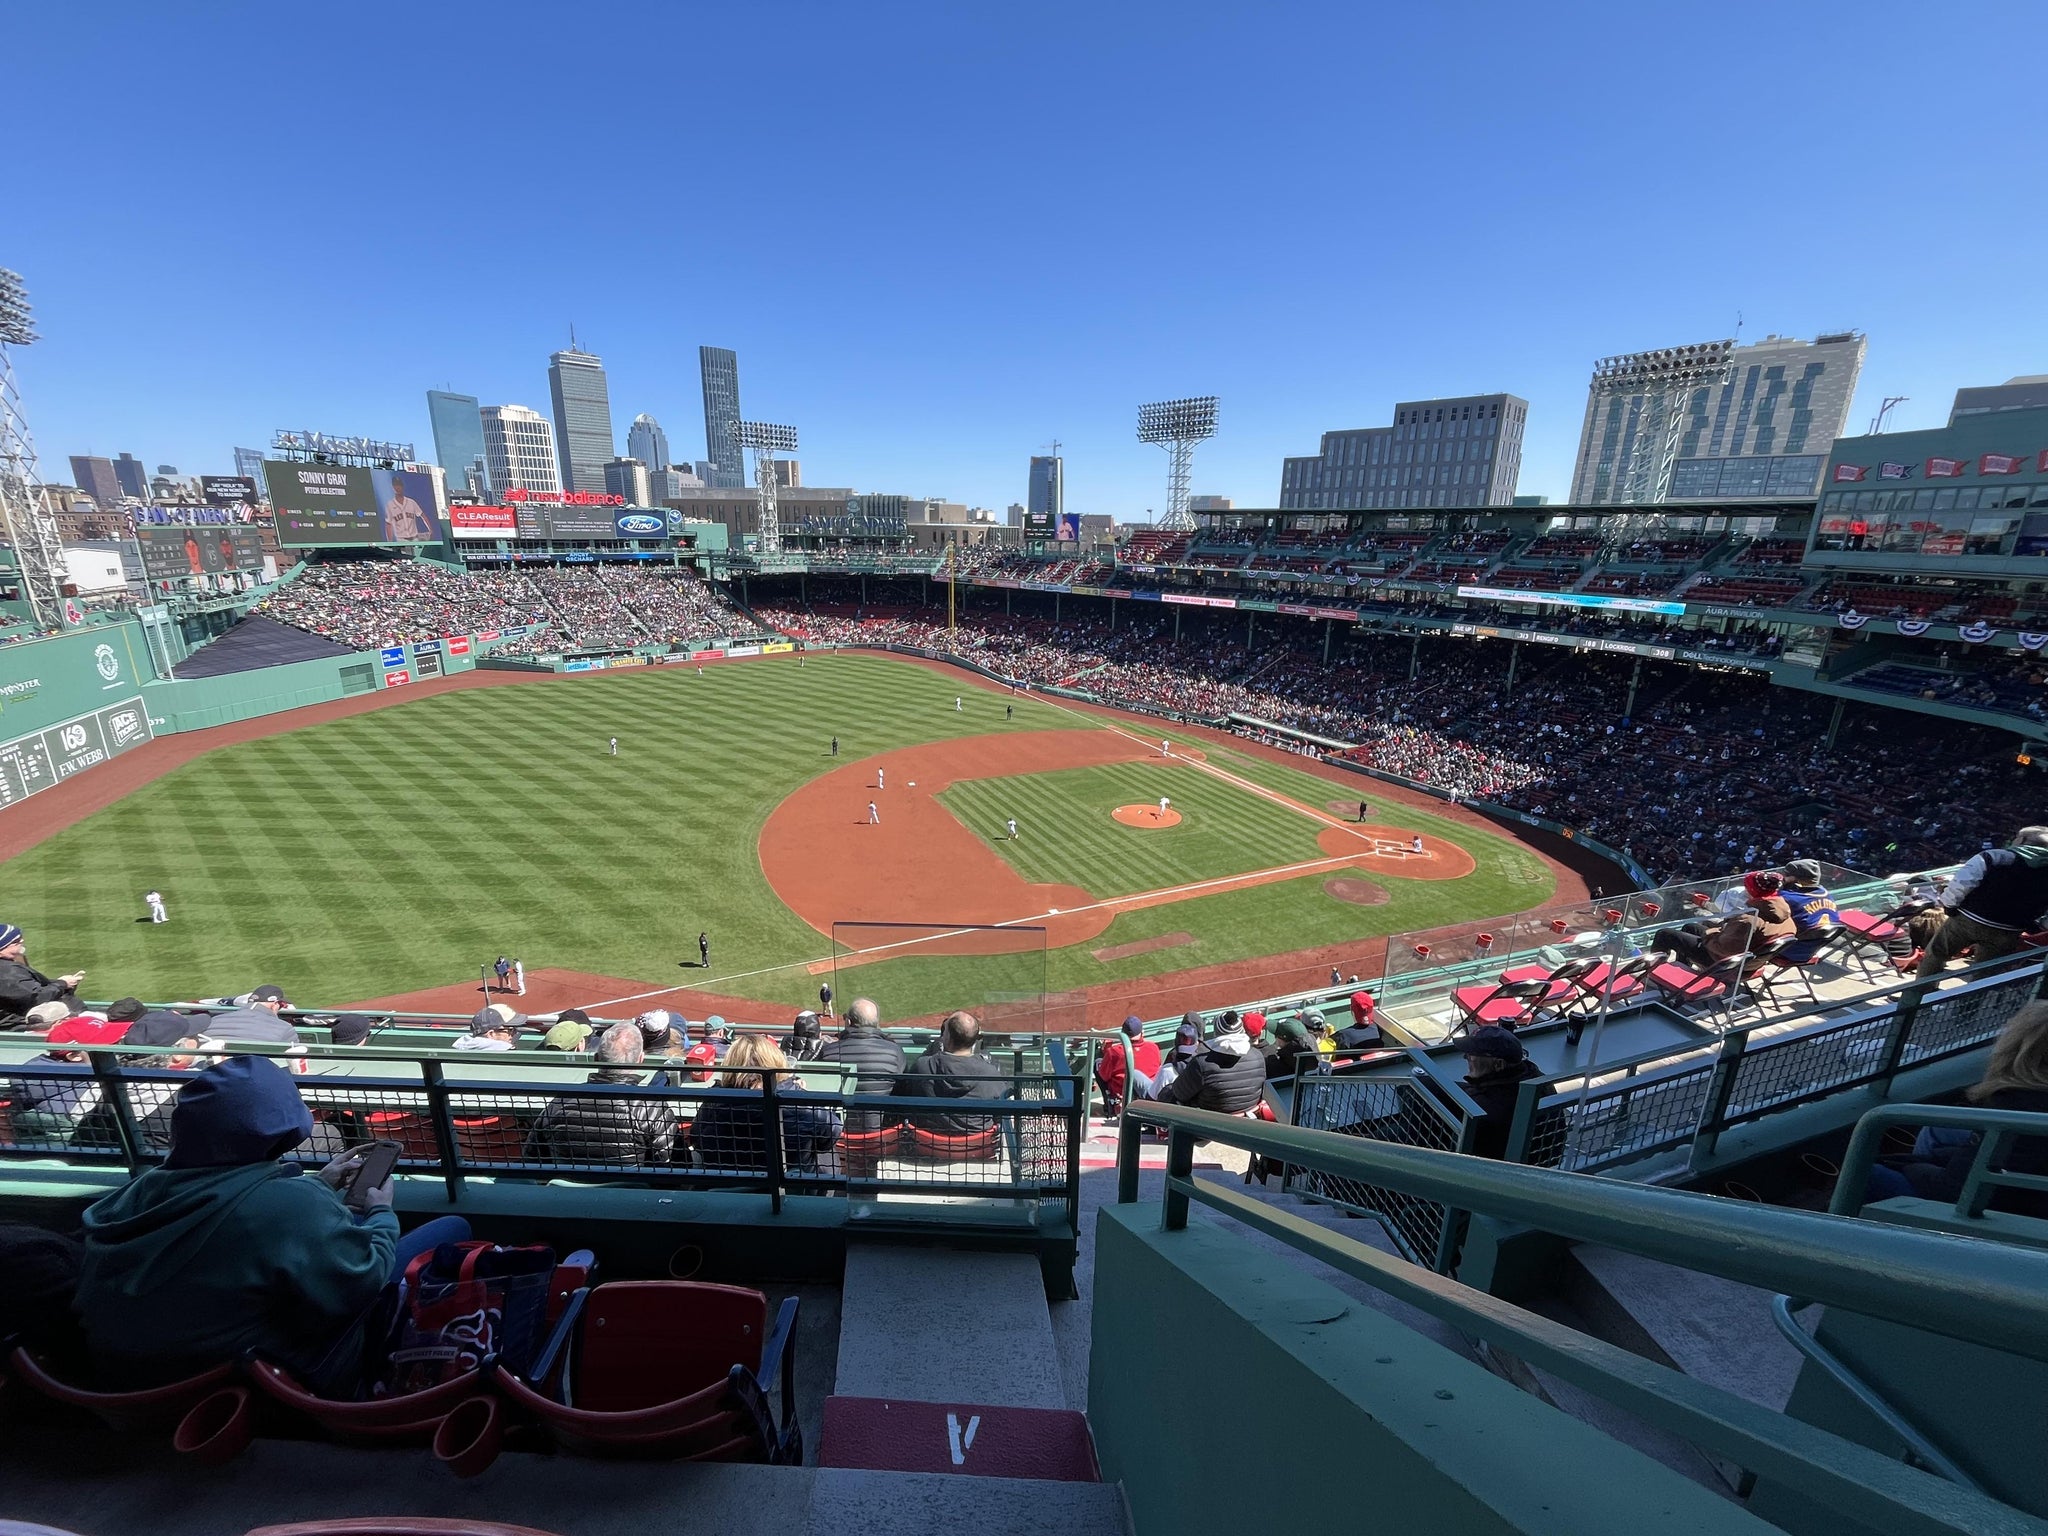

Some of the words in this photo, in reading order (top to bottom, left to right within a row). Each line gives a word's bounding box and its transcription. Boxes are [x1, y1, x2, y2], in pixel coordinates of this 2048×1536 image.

[302, 430, 415, 461] MassMutual
[298, 471, 325, 485] SONNY
[327, 473, 347, 486] GRAY
[304, 486, 320, 495] PITCH
[321, 487, 346, 496] SELECTION
[531, 491, 561, 503] new
[563, 488, 623, 506] balance
[456, 512, 511, 521] CLEAResult
[627, 517, 654, 530] Ford
[803, 515, 858, 529] SAMUEL
[863, 515, 907, 529] ADAMS
[1705, 607, 1729, 616] AURA
[1730, 609, 1764, 618] PAVILION
[419, 644, 436, 652] AURA
[1605, 643, 1636, 652] LOCKRIDGE
[114, 712, 137, 729] ACE
[118, 721, 138, 742] TICKET
[58, 761, 77, 777] F.W.
[77, 748, 104, 769] WEBB
